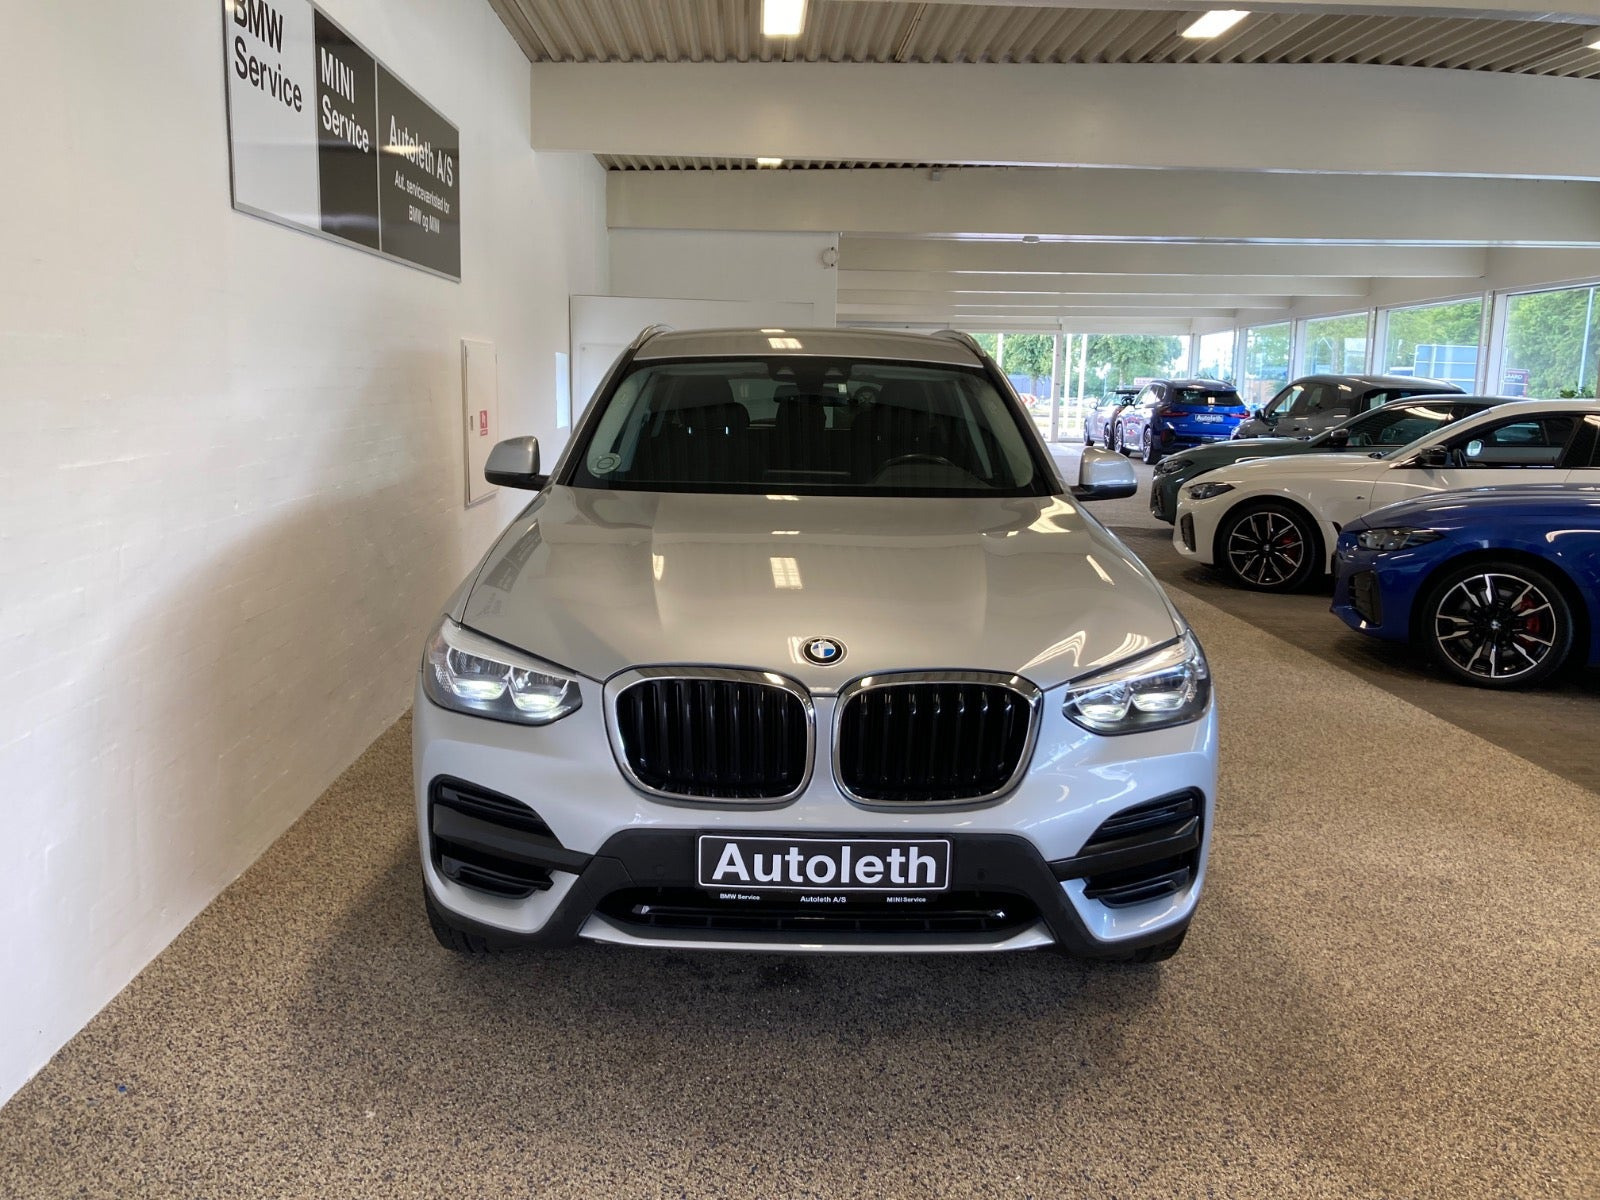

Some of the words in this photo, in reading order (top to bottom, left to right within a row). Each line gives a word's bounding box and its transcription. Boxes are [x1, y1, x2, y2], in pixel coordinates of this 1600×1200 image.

[233, 0, 283, 53] BMW
[234, 35, 302, 112] Service
[321, 46, 355, 104] MINI
[322, 94, 369, 153] Service
[389, 114, 434, 176] Autoleth
[436, 149, 453, 187] A/S
[422, 215, 428, 232] og
[711, 843, 937, 884] Autoleth
[800, 895, 831, 903] Autoleth
